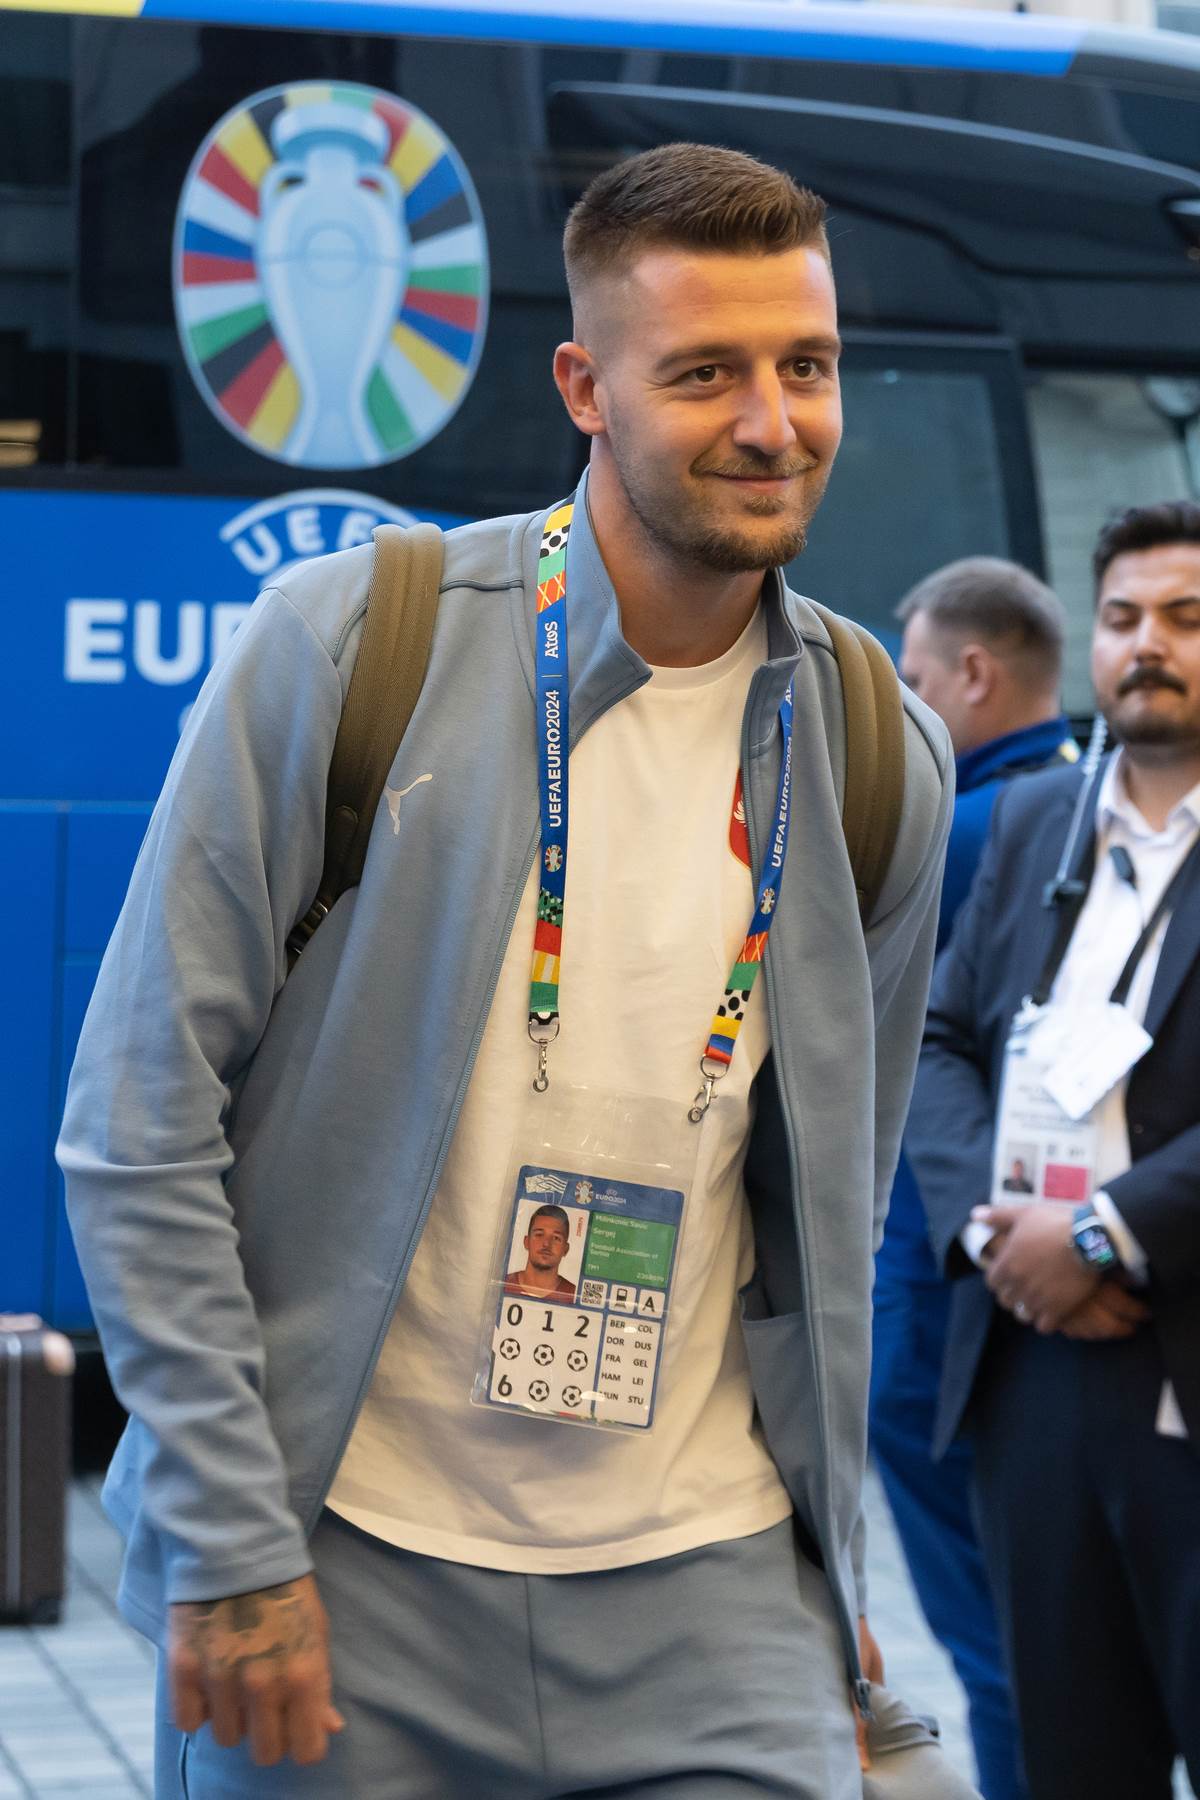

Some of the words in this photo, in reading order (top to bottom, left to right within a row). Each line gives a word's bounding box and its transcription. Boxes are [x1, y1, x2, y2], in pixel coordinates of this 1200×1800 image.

[230, 506, 378, 576] UEF
[545, 621, 558, 658] Atos
[641, 1295, 656, 1313] A
[507, 1303, 523, 1326] 0
[541, 1310, 555, 1333] 1
[573, 1315, 590, 1339] 2
[609, 1319, 626, 1329] BER
[637, 1324, 654, 1334] COL
[606, 1336, 625, 1346] DOR
[634, 1341, 652, 1352] DUS
[605, 1353, 622, 1364] FRA
[632, 1358, 649, 1368] GEL
[497, 1374, 513, 1397] 6
[600, 1371, 622, 1382] HAM
[632, 1376, 644, 1386] LEI
[627, 1395, 645, 1405] STU
